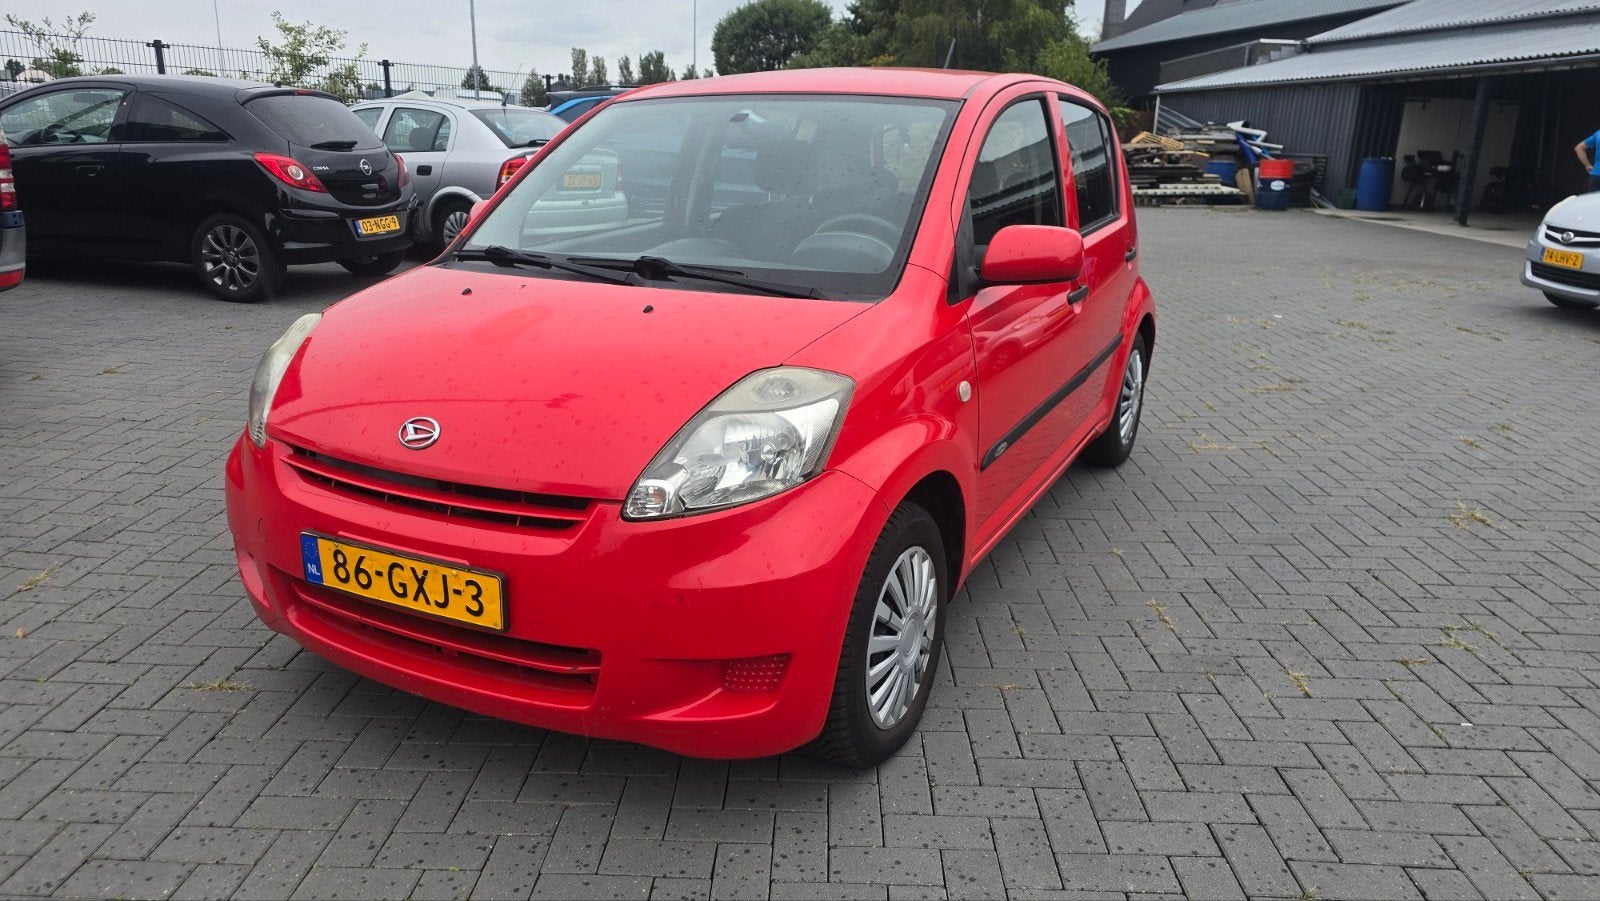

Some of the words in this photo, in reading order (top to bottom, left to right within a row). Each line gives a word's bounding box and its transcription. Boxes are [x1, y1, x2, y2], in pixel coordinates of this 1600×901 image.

[361, 217, 397, 232] 03-NGG-9
[1545, 249, 1579, 266] 74-LHV-2
[307, 563, 320, 576] NL
[332, 548, 485, 618] 86-GXJ-3
